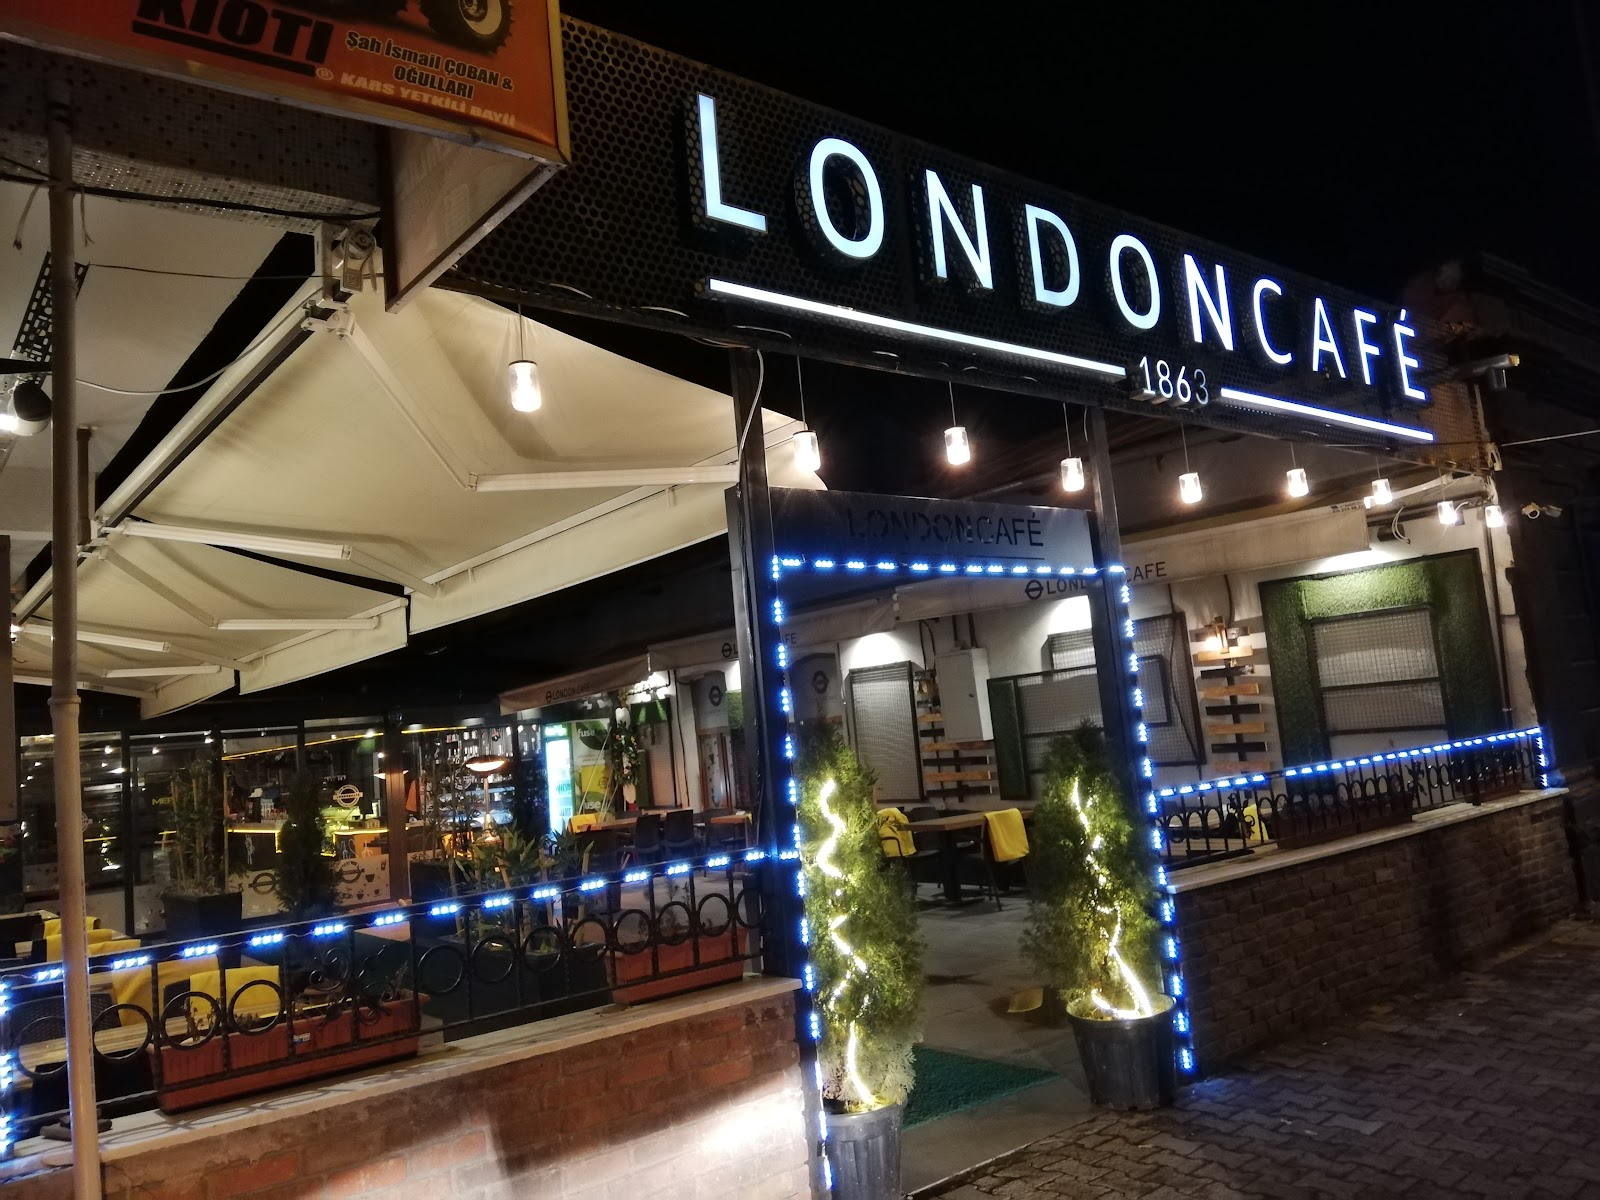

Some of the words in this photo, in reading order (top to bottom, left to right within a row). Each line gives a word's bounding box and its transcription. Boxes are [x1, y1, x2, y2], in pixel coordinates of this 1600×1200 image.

[345, 31, 382, 54] Şah
[384, 39, 442, 71] İsmail
[444, 57, 500, 88] ÇOBAN
[501, 76, 514, 92] &
[393, 65, 474, 100] OĞULLARI
[340, 72, 396, 96] KARS
[400, 86, 466, 113] YETKİLİ
[1139, 356, 1209, 405] 1863
